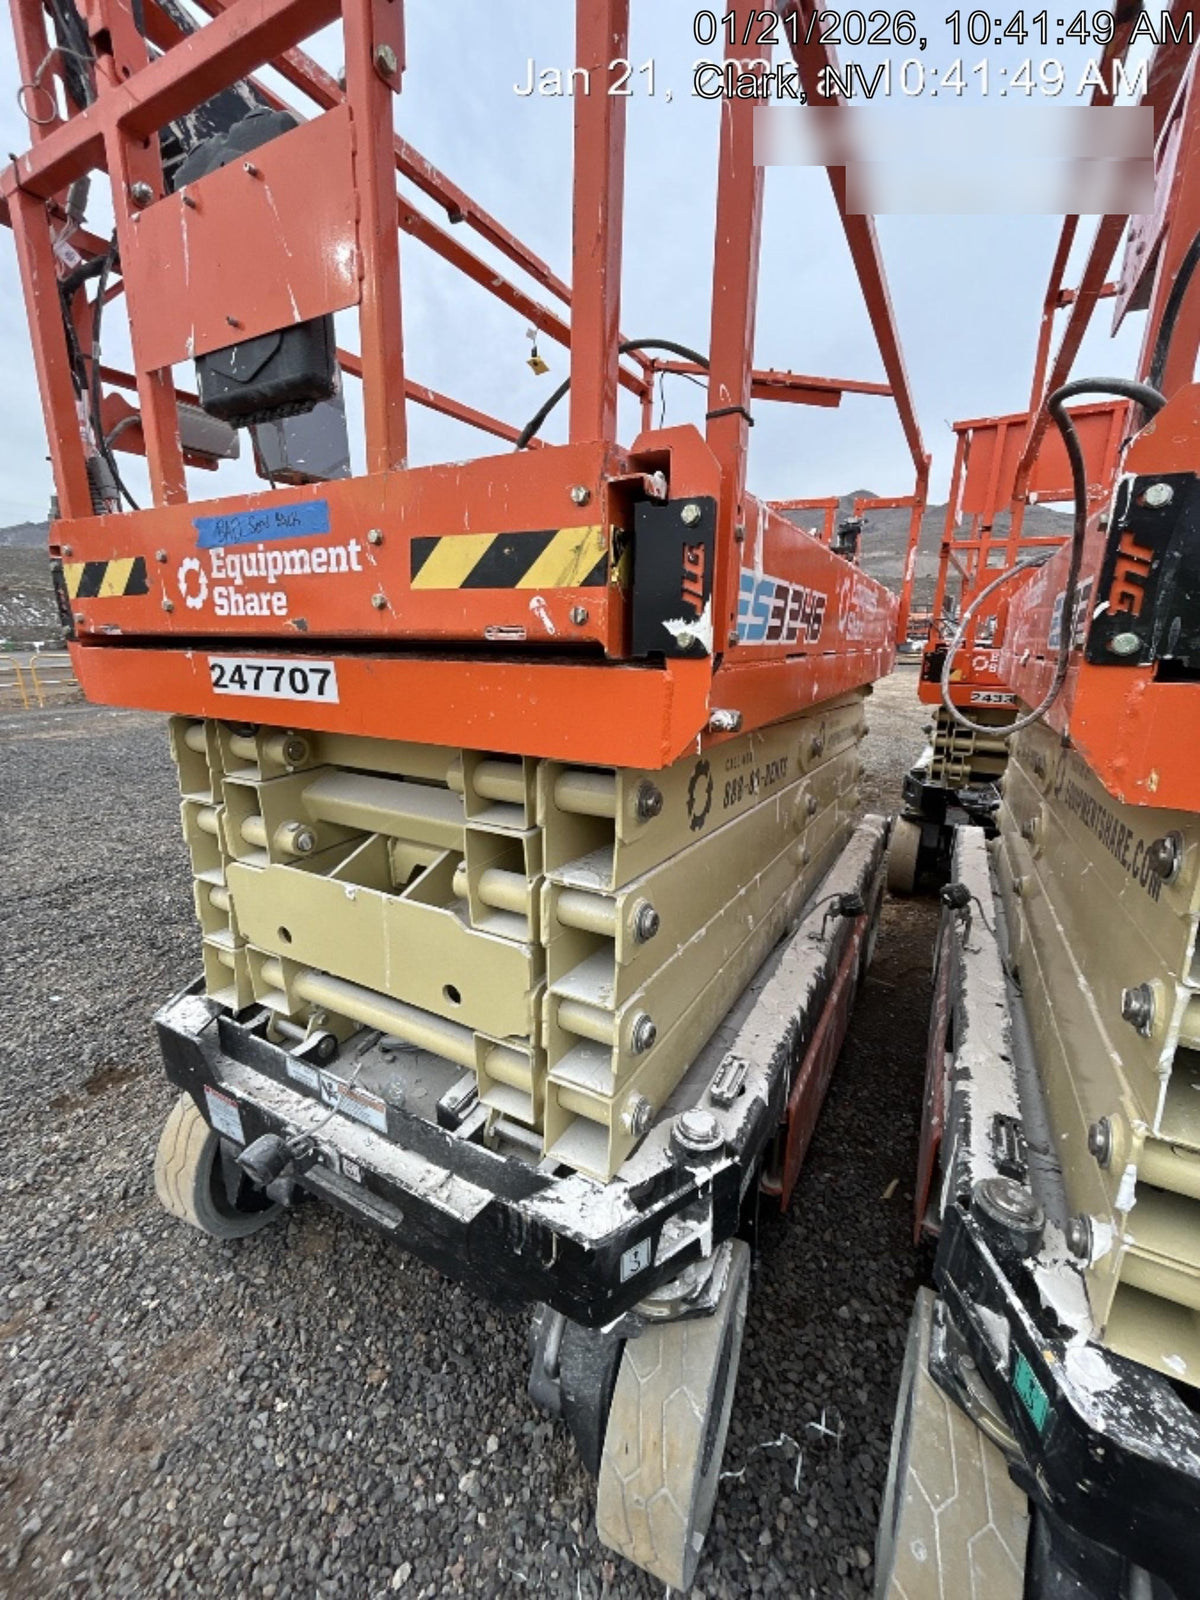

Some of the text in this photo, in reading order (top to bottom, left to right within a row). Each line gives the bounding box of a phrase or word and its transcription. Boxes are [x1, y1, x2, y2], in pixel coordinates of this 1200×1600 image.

[209, 539, 363, 585] Equipment
[681, 543, 705, 616] JLG
[1107, 532, 1154, 617] JLG
[213, 586, 288, 616] Share
[210, 662, 332, 696] 247707
